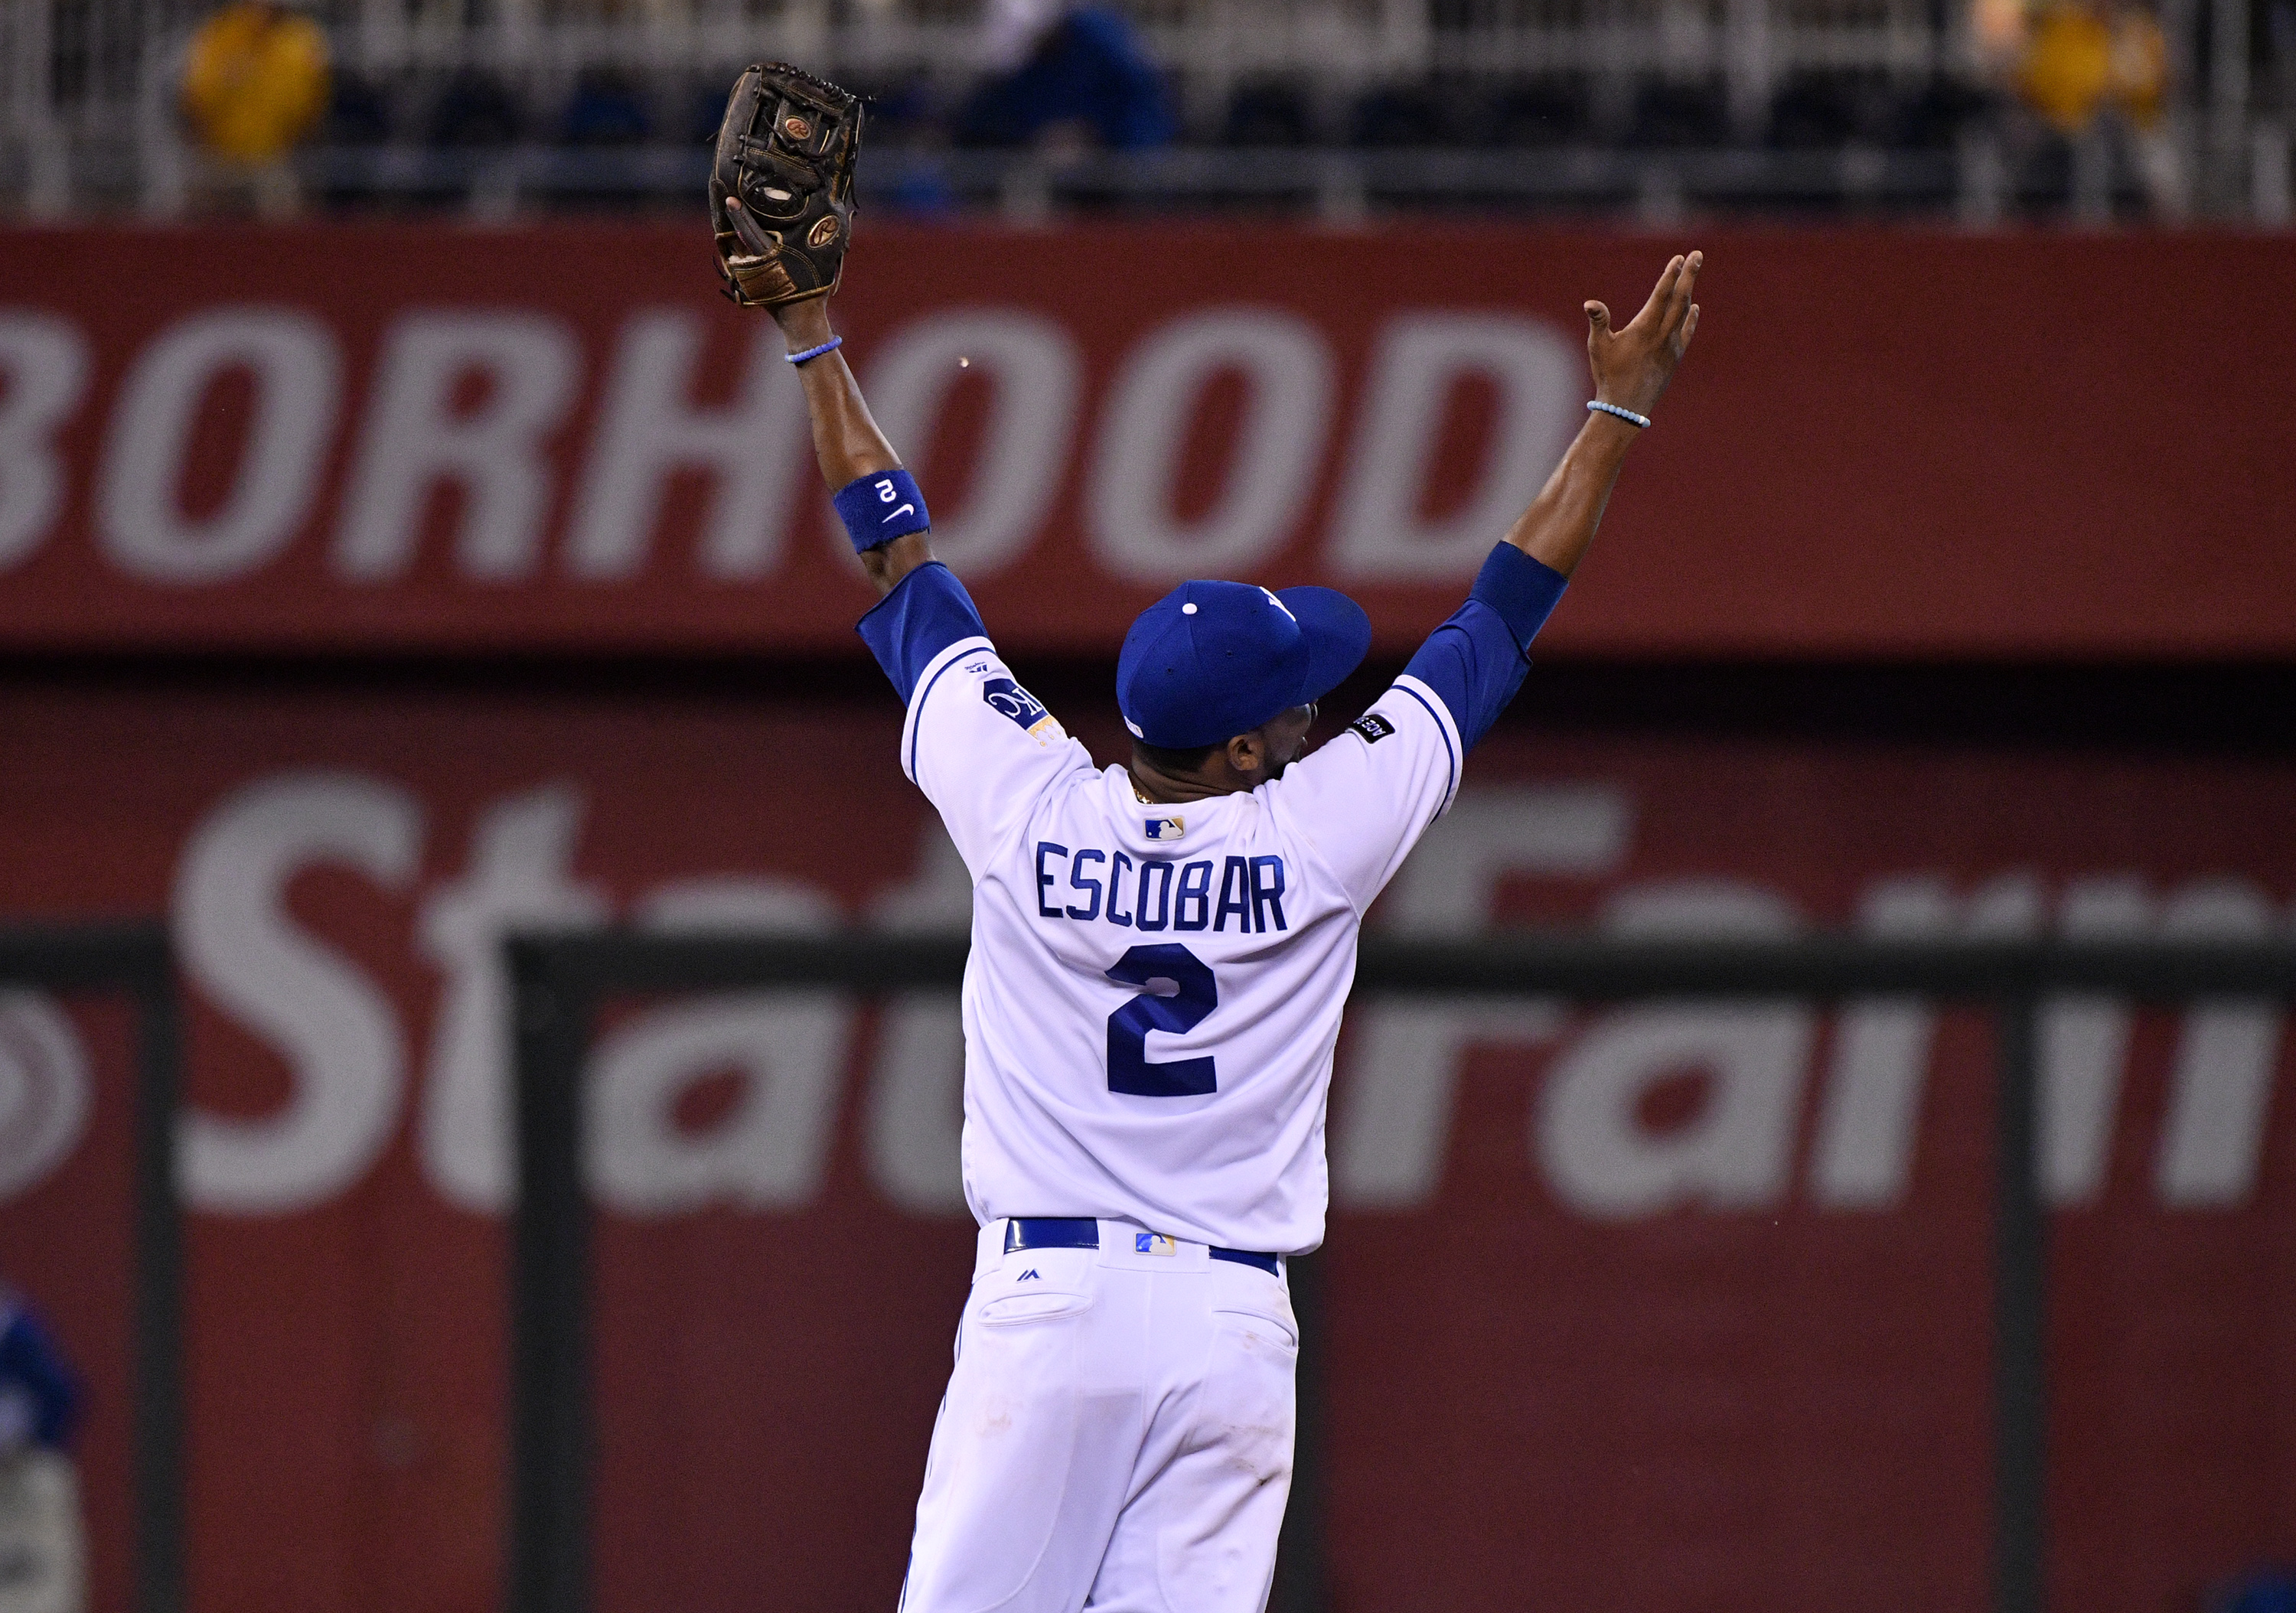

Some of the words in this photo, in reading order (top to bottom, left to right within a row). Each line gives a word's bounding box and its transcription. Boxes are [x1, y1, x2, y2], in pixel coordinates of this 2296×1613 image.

[876, 479, 896, 502] 2
[1035, 840, 1288, 934] ESCOBAR
[173, 768, 964, 1220] Sta
[1104, 942, 1218, 1097] 2
